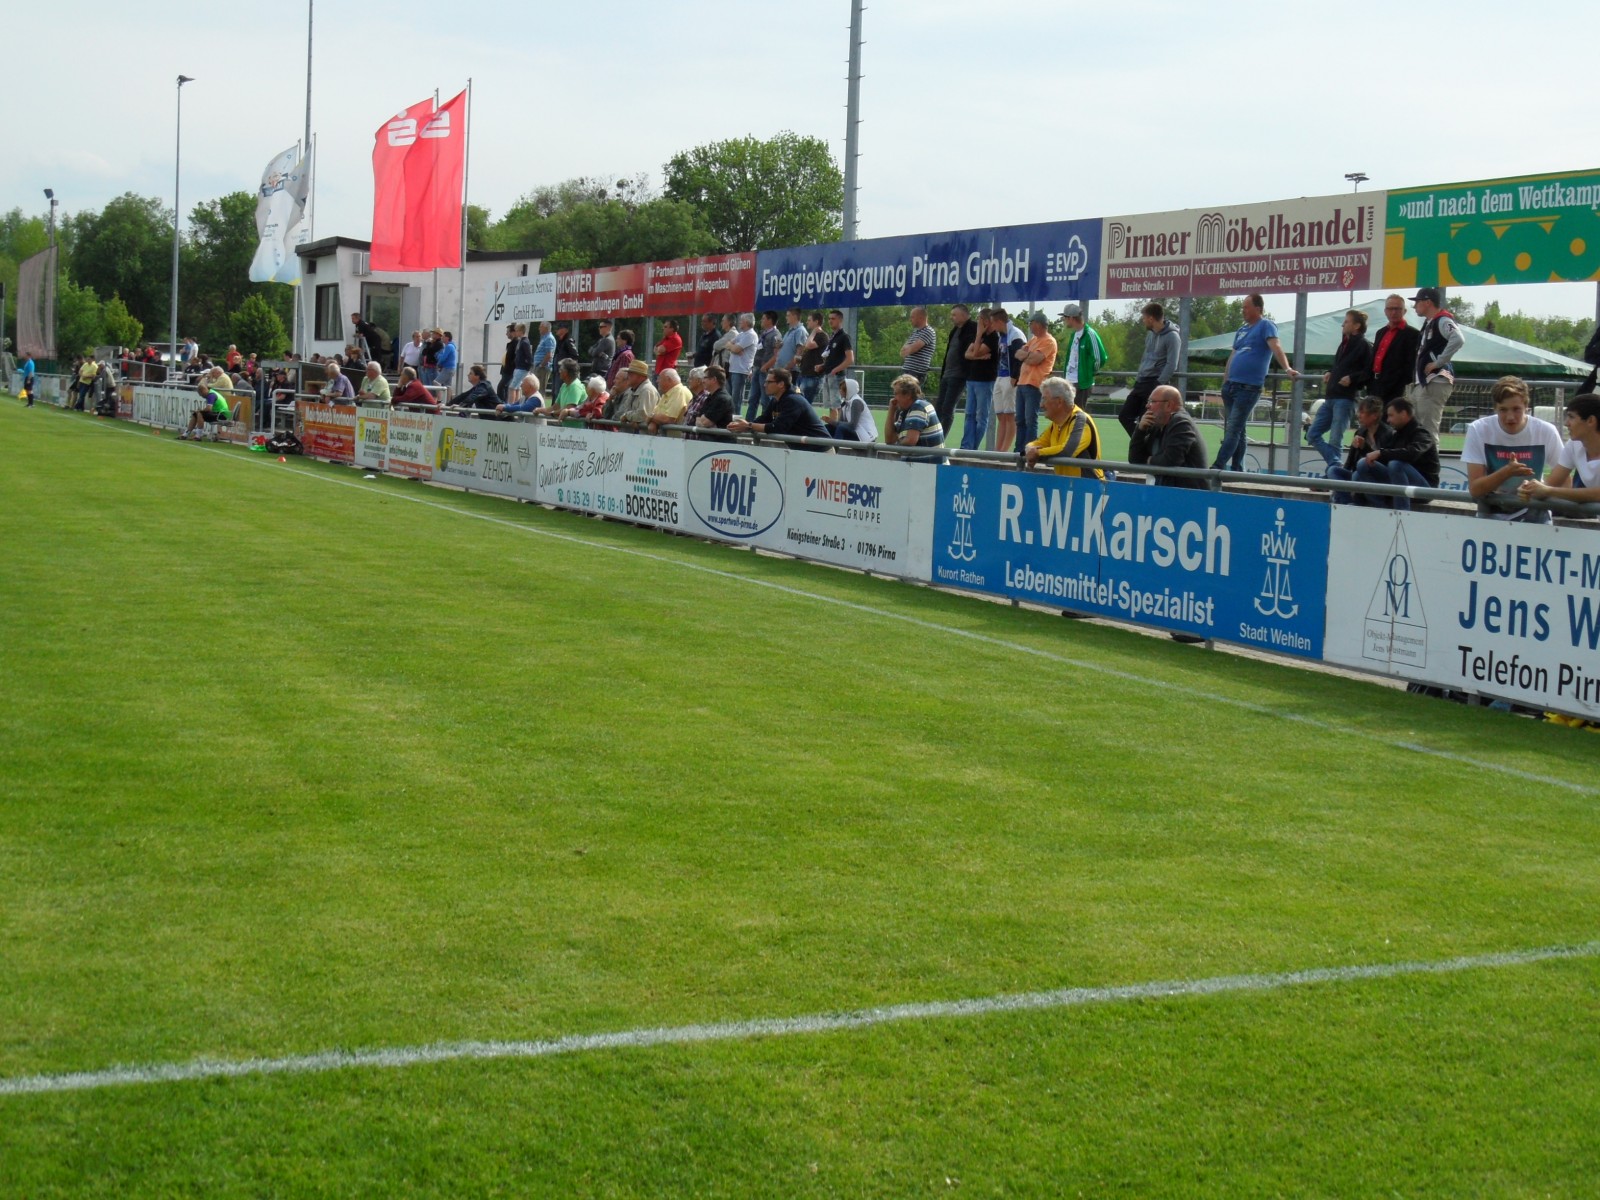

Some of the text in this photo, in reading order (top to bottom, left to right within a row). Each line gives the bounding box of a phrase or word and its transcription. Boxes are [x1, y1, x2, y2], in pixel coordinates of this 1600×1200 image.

[1438, 190, 1476, 217] nach
[1481, 189, 1513, 214] dem
[1108, 206, 1365, 260] Pirnaer Möbelhandel
[1366, 206, 1375, 241] GmbH
[656, 265, 674, 277] Partner
[675, 266, 686, 276] zum
[686, 261, 717, 274] Vorwärmen
[719, 259, 730, 271] und
[730, 258, 751, 271] Glühen
[1056, 252, 1079, 273] EVP
[1109, 264, 1189, 279] WOHNRAUMSTUDIO
[1194, 253, 1369, 276] KÜCHENSTUDIO NEUE WOHNIDEEN
[557, 273, 592, 294] RICHTER
[647, 282, 655, 294] im
[696, 278, 730, 293] Anlagenbau
[762, 247, 1030, 303] Energieversorgung Pirna GmbH
[1121, 279, 1174, 292] Breite Straße 11
[1219, 275, 1276, 289] Rottwerndorfer
[1277, 274, 1291, 286] Str.
[1293, 273, 1303, 285] 43
[1305, 273, 1317, 285] im
[1319, 271, 1337, 285] PEZ
[507, 278, 553, 295] Immobilien Service
[513, 304, 544, 320] GmbH Pirna
[557, 297, 620, 314] Wärmebehandlungen
[622, 293, 644, 310] GmbH
[456, 429, 477, 440] Autohaus
[486, 432, 509, 454] PIRNA
[441, 428, 477, 466] Ritter
[482, 459, 513, 483] ZEHISTA
[540, 447, 624, 492] Qualität aus Sachsen
[711, 458, 731, 472] SPORT
[573, 490, 580, 505] 35
[582, 491, 590, 507] 29
[597, 494, 606, 510] 56
[650, 488, 679, 500] KIESWERKE
[710, 471, 758, 517] WOLF
[816, 479, 882, 509] INTERSPORT
[952, 487, 976, 515] RWK
[626, 494, 679, 524] BORSBERG
[846, 508, 881, 524] GRUPPE
[708, 515, 758, 530] www.sportwolf-pirna.de
[999, 483, 1230, 576] R.W.Karsch
[787, 527, 896, 560] Königsteiner Straße 3 01796 Pirna
[1261, 530, 1297, 560] RWK
[937, 565, 985, 586] Kurort Rathen
[1005, 560, 1214, 627] Lebensmittel-Spezialist
[1458, 580, 1550, 642] Jens
[1239, 622, 1311, 651] Stadt Wehlen
[1371, 642, 1386, 653] Jens
[1458, 645, 1548, 693] Telefon
